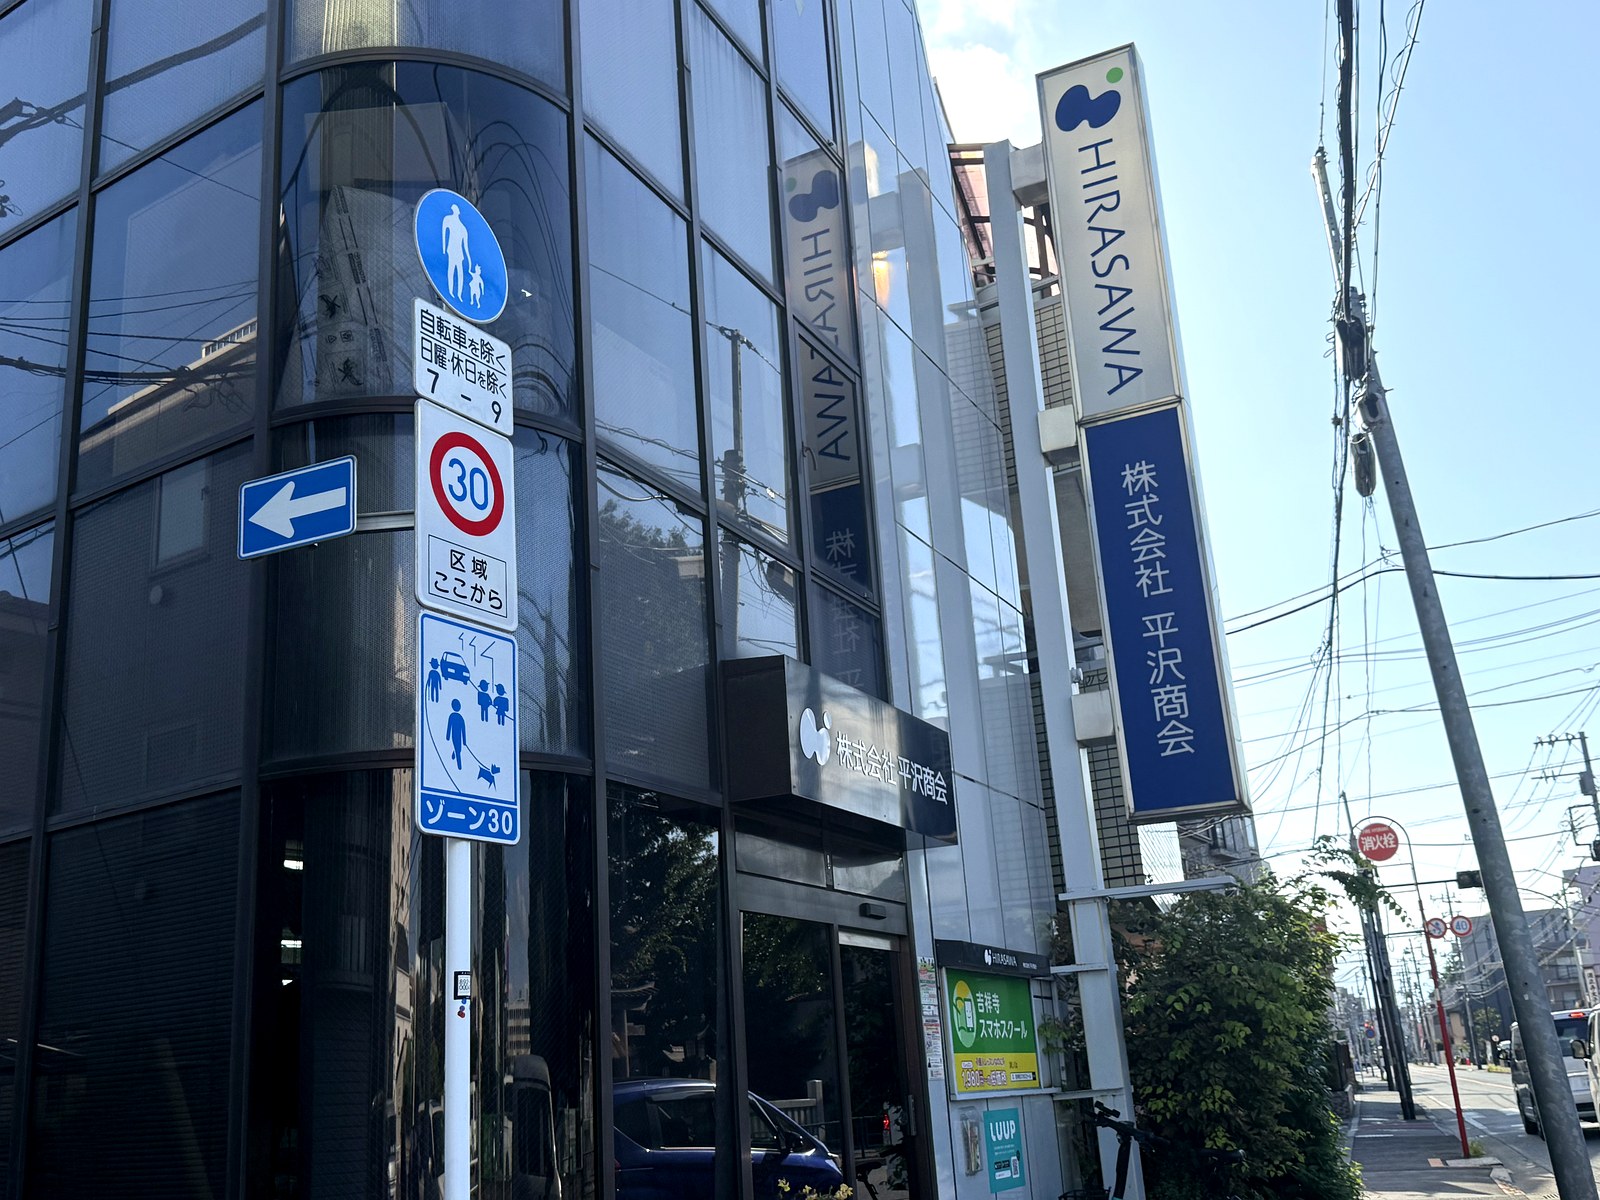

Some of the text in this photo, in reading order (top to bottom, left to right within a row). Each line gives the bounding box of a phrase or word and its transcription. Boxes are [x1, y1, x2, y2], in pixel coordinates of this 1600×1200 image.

[1078, 138, 1144, 396] HIRASAWA
[420, 309, 506, 371] 自転車を除く
[427, 368, 439, 394] 7
[491, 401, 502, 424] 9
[448, 457, 489, 511] 30
[450, 549, 488, 581] 区域
[434, 571, 503, 610] ここから
[1120, 460, 1195, 758] 株式会社 平沢商会
[836, 730, 948, 805] 株式会社 平沢商会
[426, 799, 513, 835] ゾーン30
[1361, 832, 1397, 851] 消火栓
[1455, 921, 1467, 931] 40
[976, 991, 1000, 1014] 吉祥寺
[979, 1018, 1028, 1040] スマホスクール
[989, 1119, 1016, 1142] LUUP
